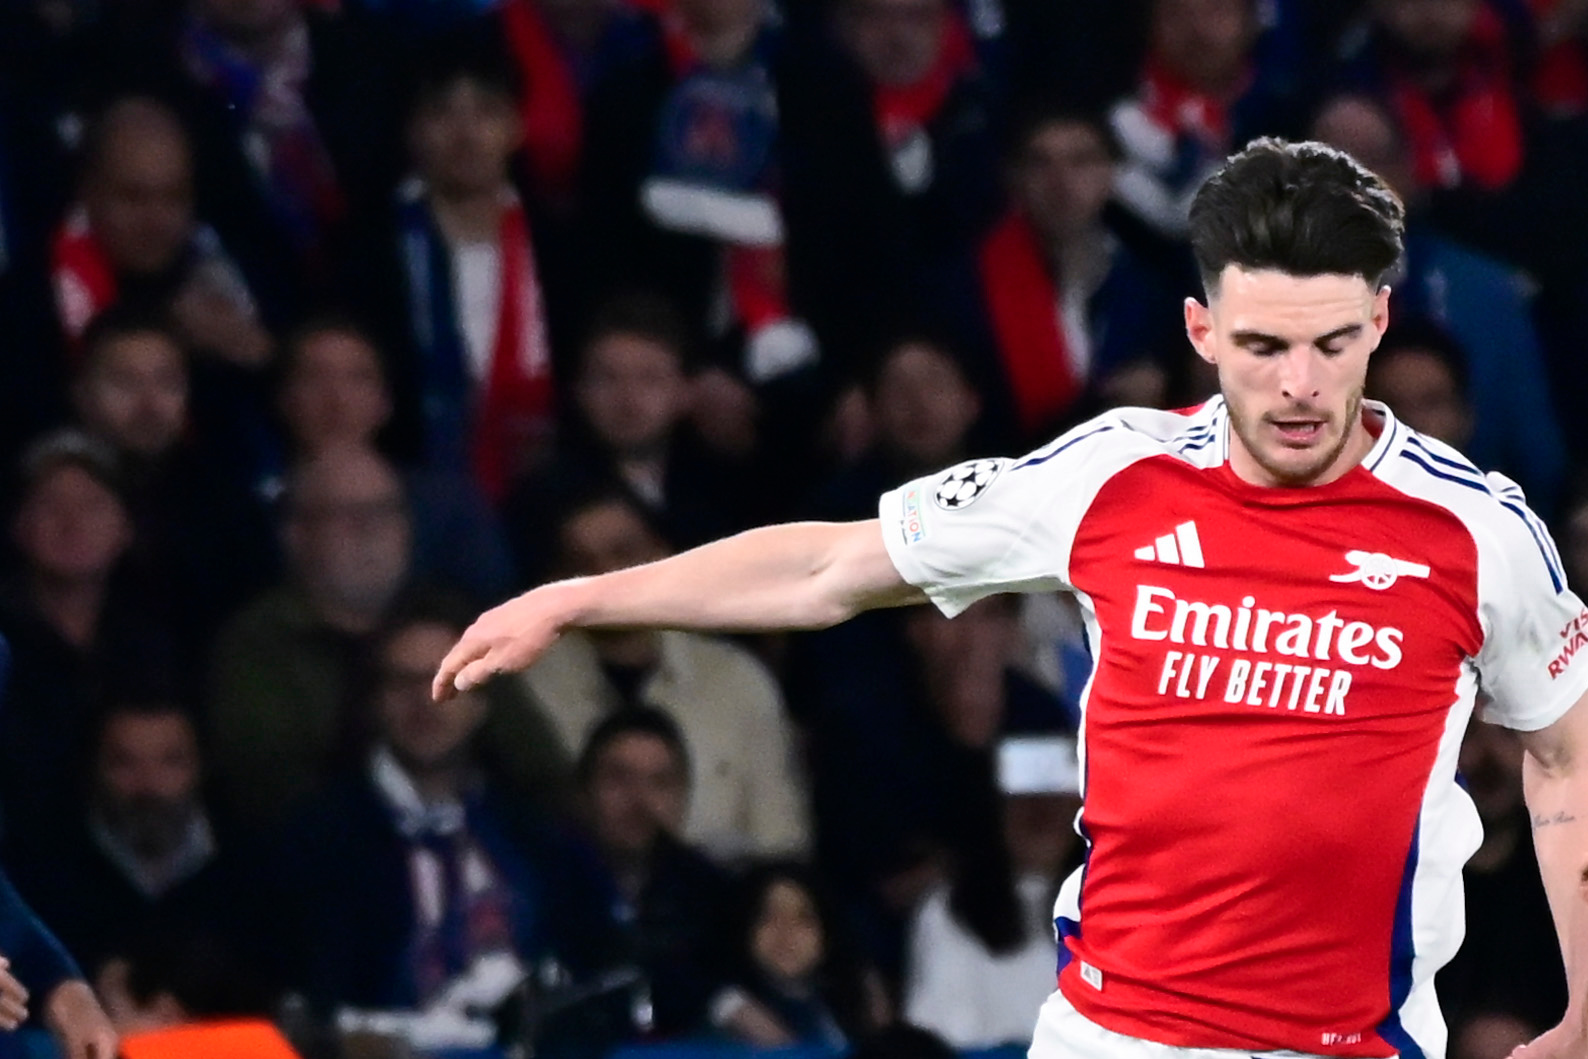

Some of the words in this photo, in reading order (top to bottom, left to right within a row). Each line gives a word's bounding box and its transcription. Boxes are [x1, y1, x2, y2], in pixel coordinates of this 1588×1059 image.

[1131, 585, 1403, 669] Emirates
[1158, 650, 1220, 699] FLY
[1224, 659, 1353, 716] BETTER
